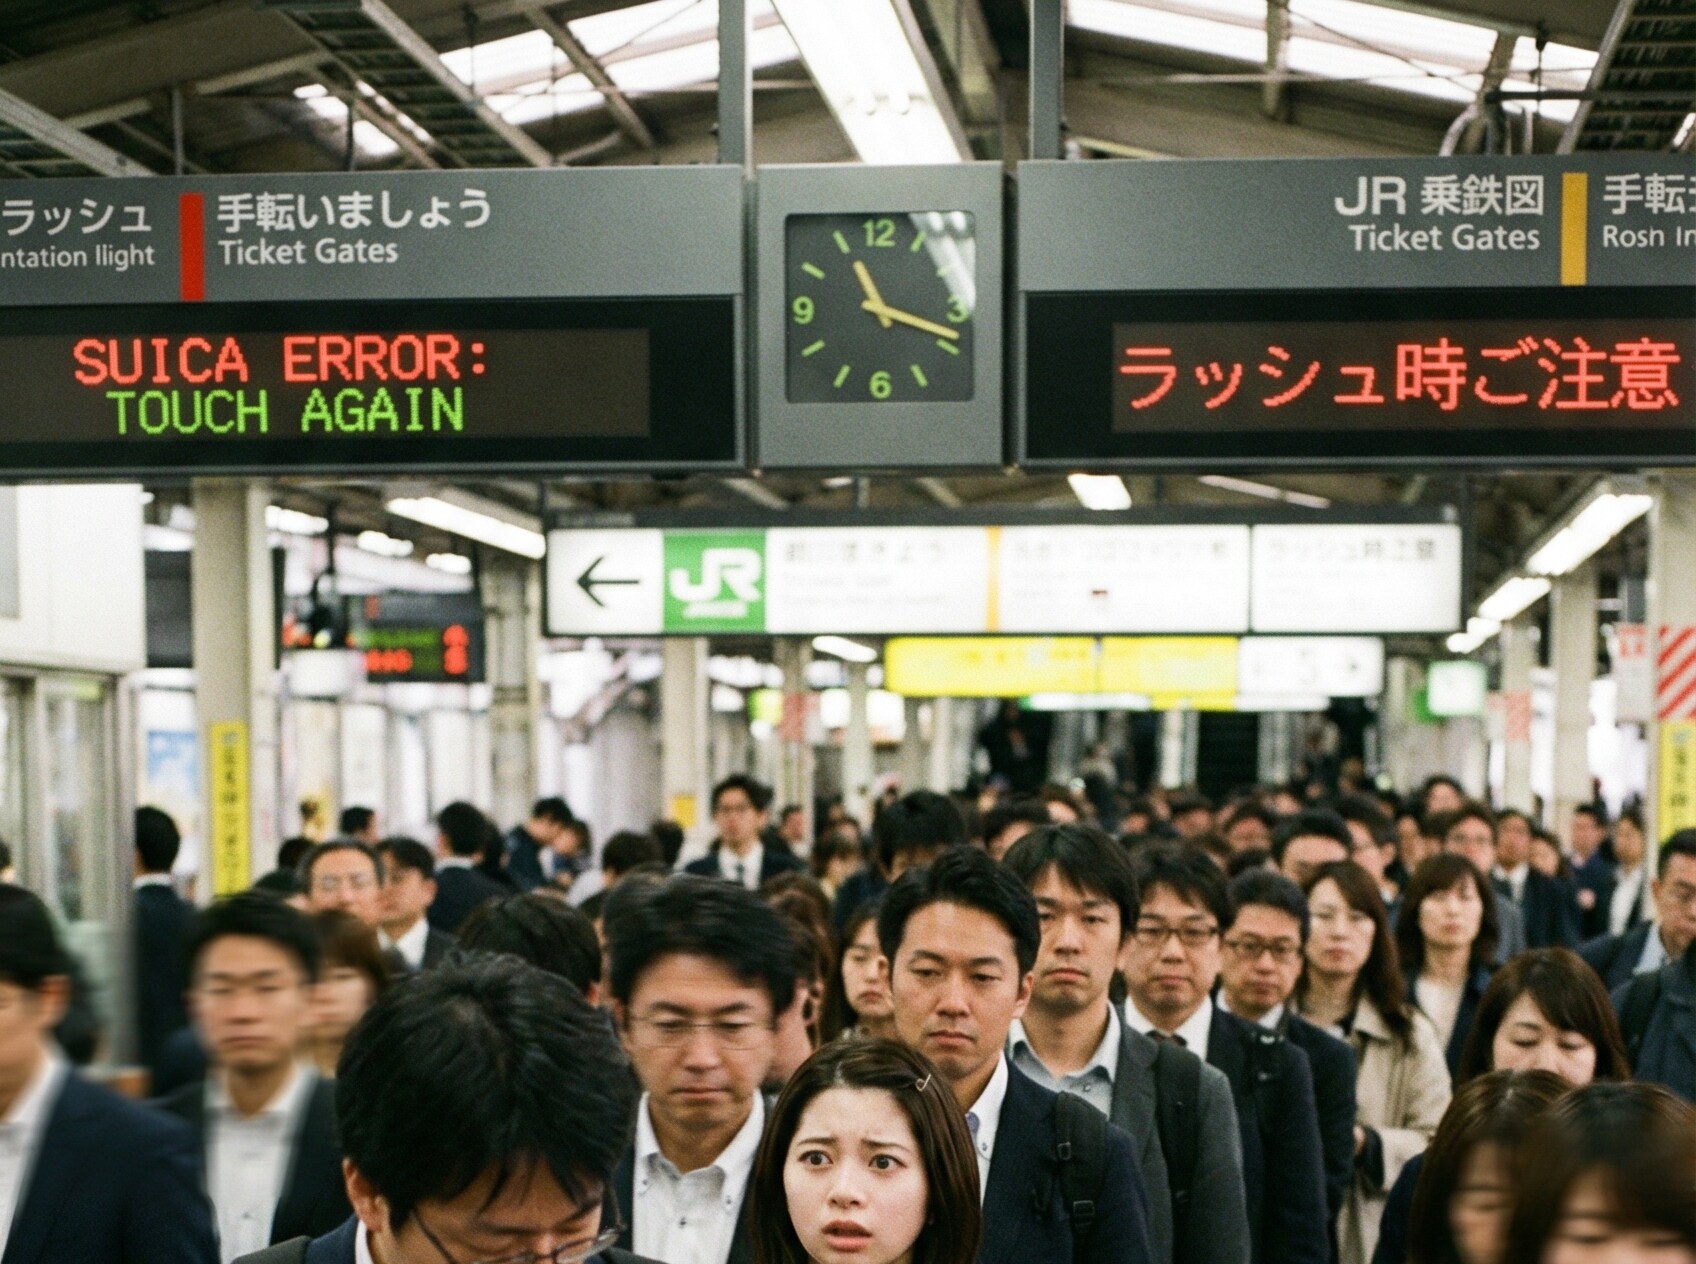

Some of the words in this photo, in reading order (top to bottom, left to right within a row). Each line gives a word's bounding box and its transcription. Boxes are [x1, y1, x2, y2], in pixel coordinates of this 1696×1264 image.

[217, 187, 491, 234] 手転いましょう
[1334, 175, 1407, 216] JR
[1420, 174, 1544, 216] 乗鉄図
[1603, 172, 1696, 216] 手転
[2, 198, 152, 237] ラッシュ
[863, 218, 896, 247] 12
[1348, 222, 1443, 251] Ticket
[1451, 223, 1540, 251] Gates
[217, 238, 307, 266] Ticket
[315, 237, 399, 265] Gates
[793, 296, 815, 324] 9
[946, 295, 969, 323] 3
[73, 338, 249, 386] SUICA
[284, 334, 487, 383] ERROR:
[1119, 336, 1681, 410] ラッシュ時ご注意
[869, 370, 892, 399] 6
[106, 389, 269, 435] TOUCH
[301, 386, 463, 433] AGAIN
[669, 547, 761, 602] JR
